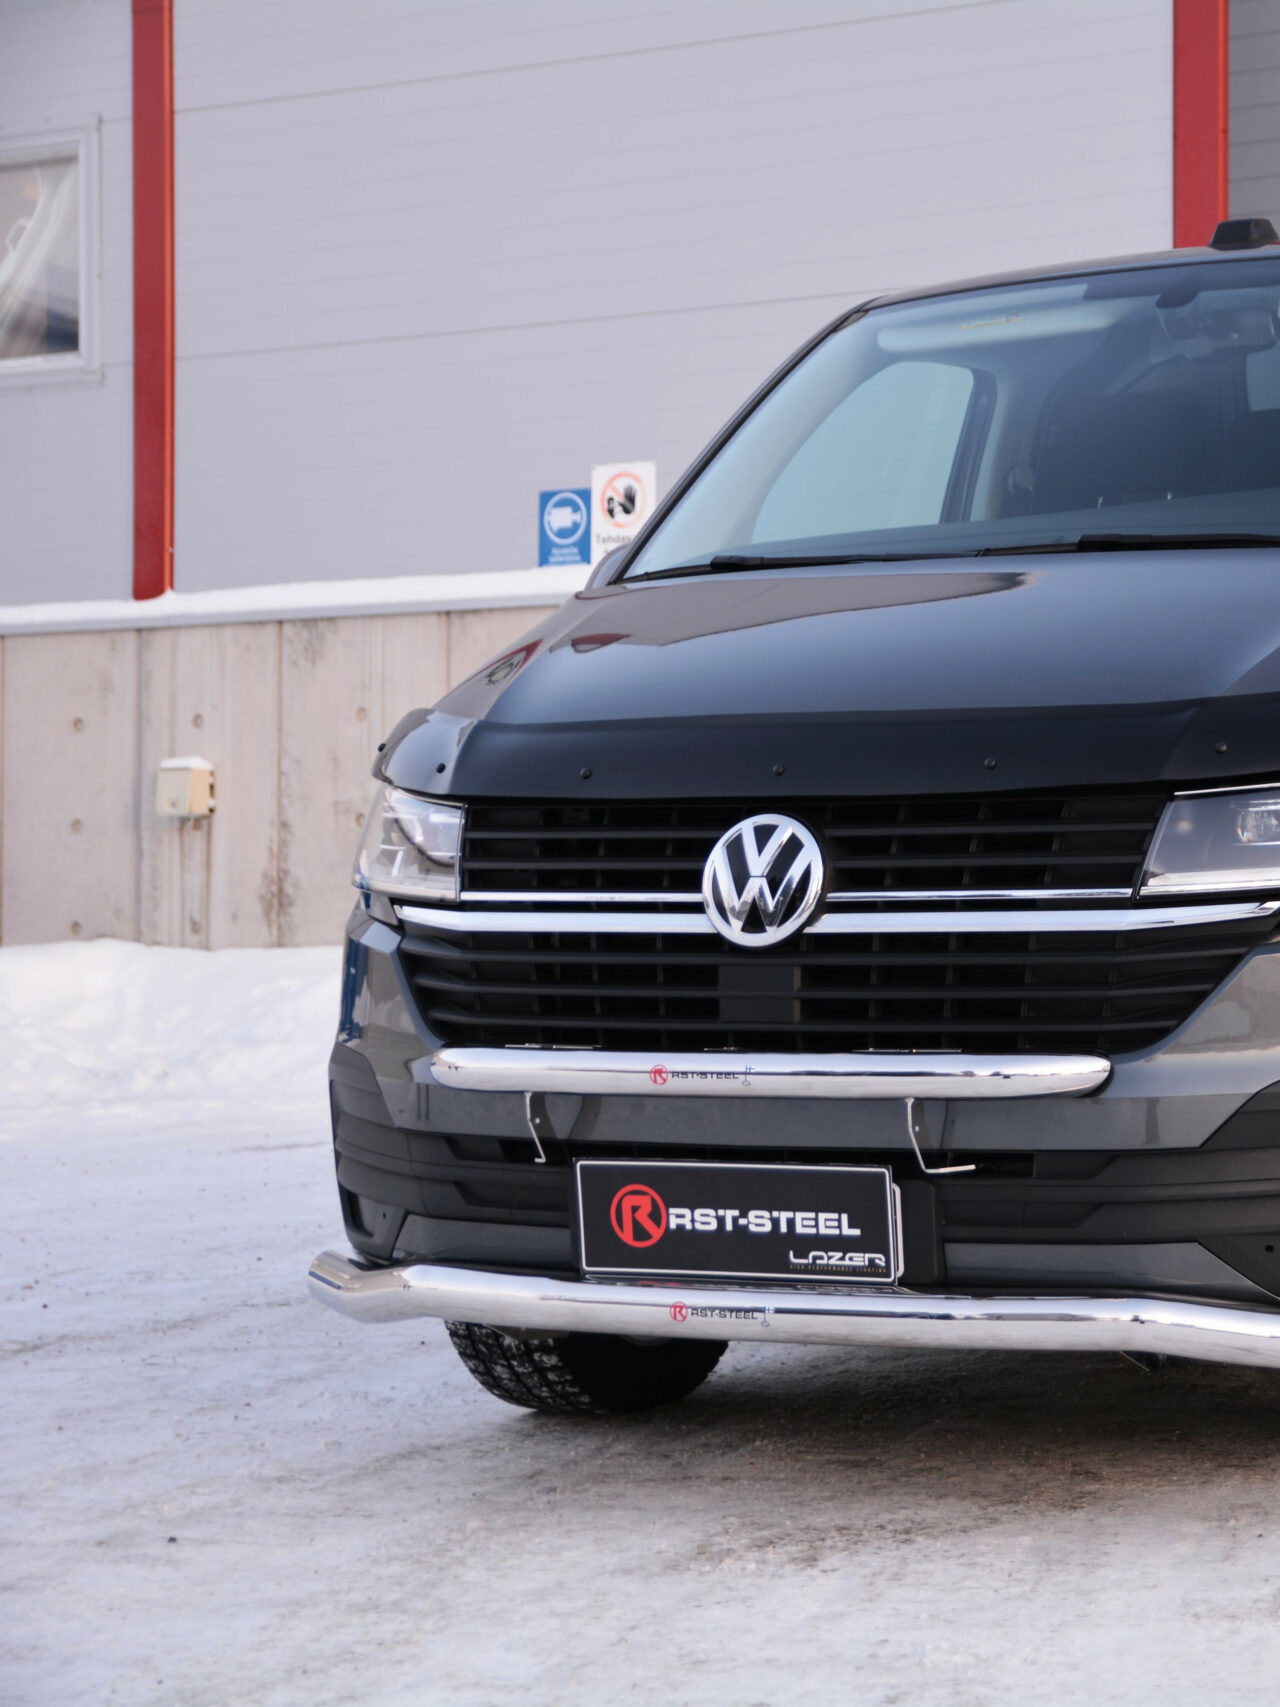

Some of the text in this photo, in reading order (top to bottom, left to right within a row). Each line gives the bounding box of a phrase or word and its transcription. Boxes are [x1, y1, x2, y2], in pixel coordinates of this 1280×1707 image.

[672, 1070, 739, 1079] RST-STEEL
[669, 1207, 861, 1236] RST-STEEL
[789, 1250, 886, 1266] LAZER
[691, 1307, 758, 1320] RST-STEEL
